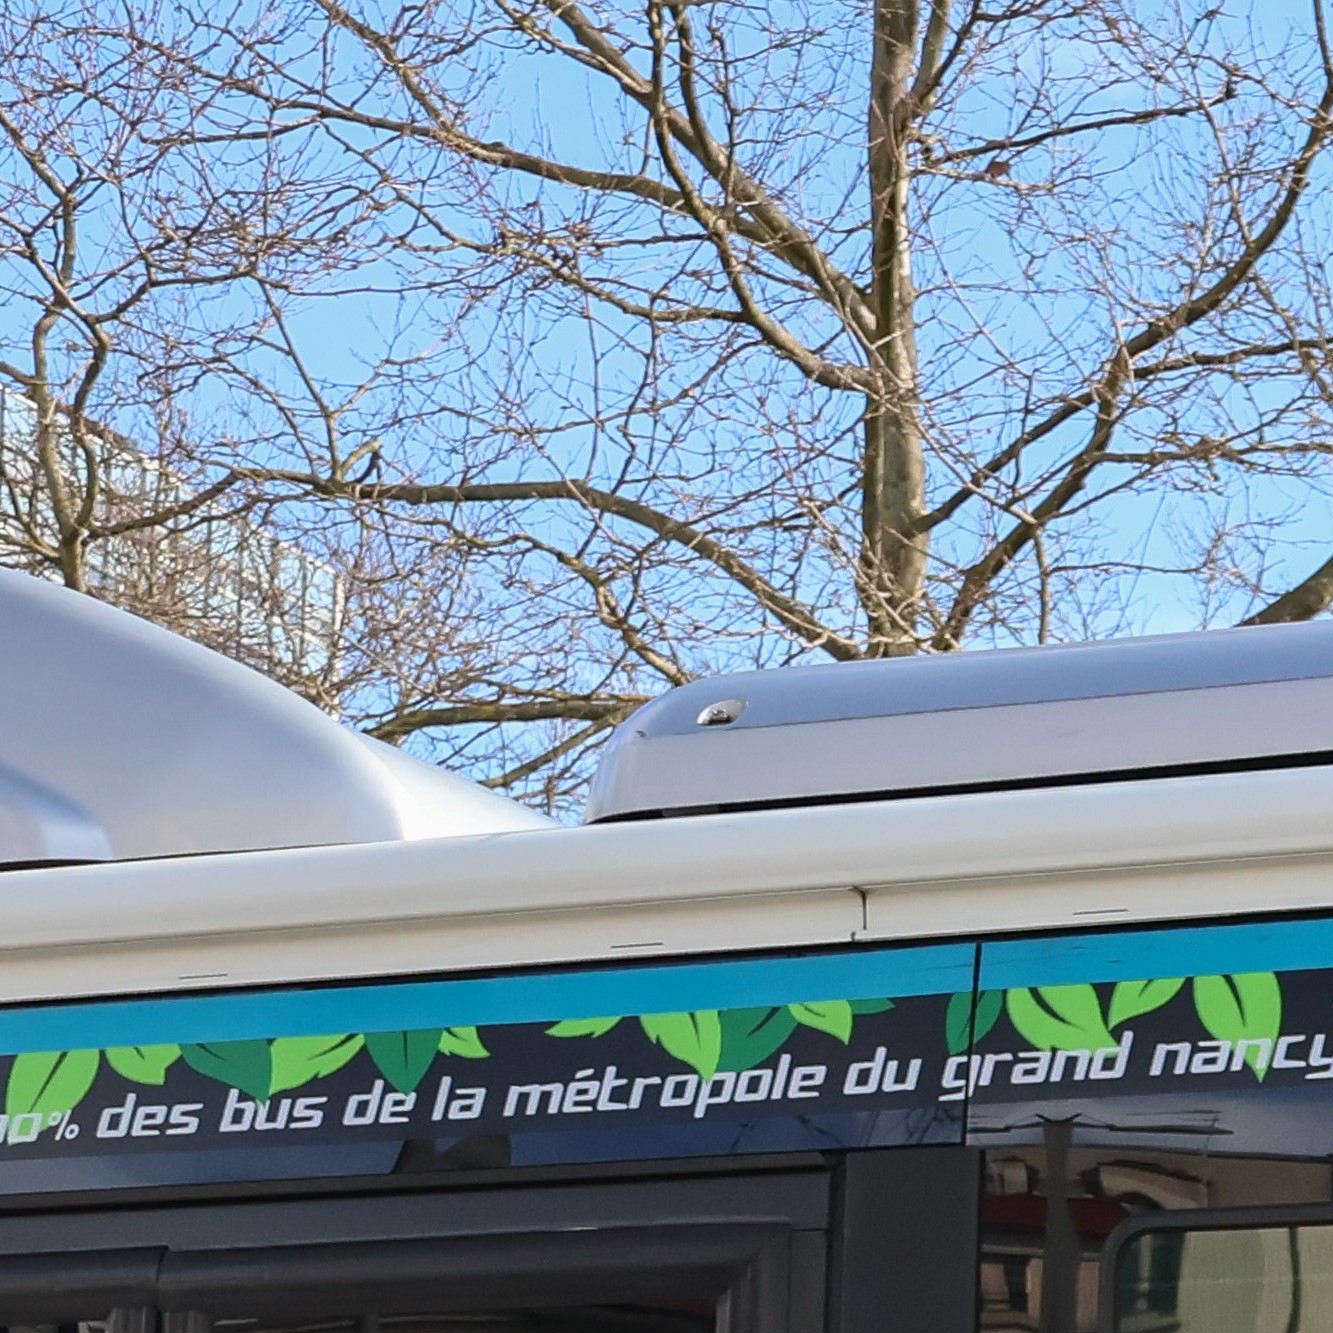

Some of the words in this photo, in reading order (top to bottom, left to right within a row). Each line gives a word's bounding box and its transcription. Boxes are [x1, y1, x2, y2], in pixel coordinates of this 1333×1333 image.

[97, 1092, 203, 1138] des
[219, 1088, 328, 1133] bus
[342, 1079, 418, 1126] de
[431, 1076, 486, 1121] la
[503, 1052, 827, 1119] métropole
[843, 1046, 922, 1096] du
[938, 1029, 1135, 1102] grand
